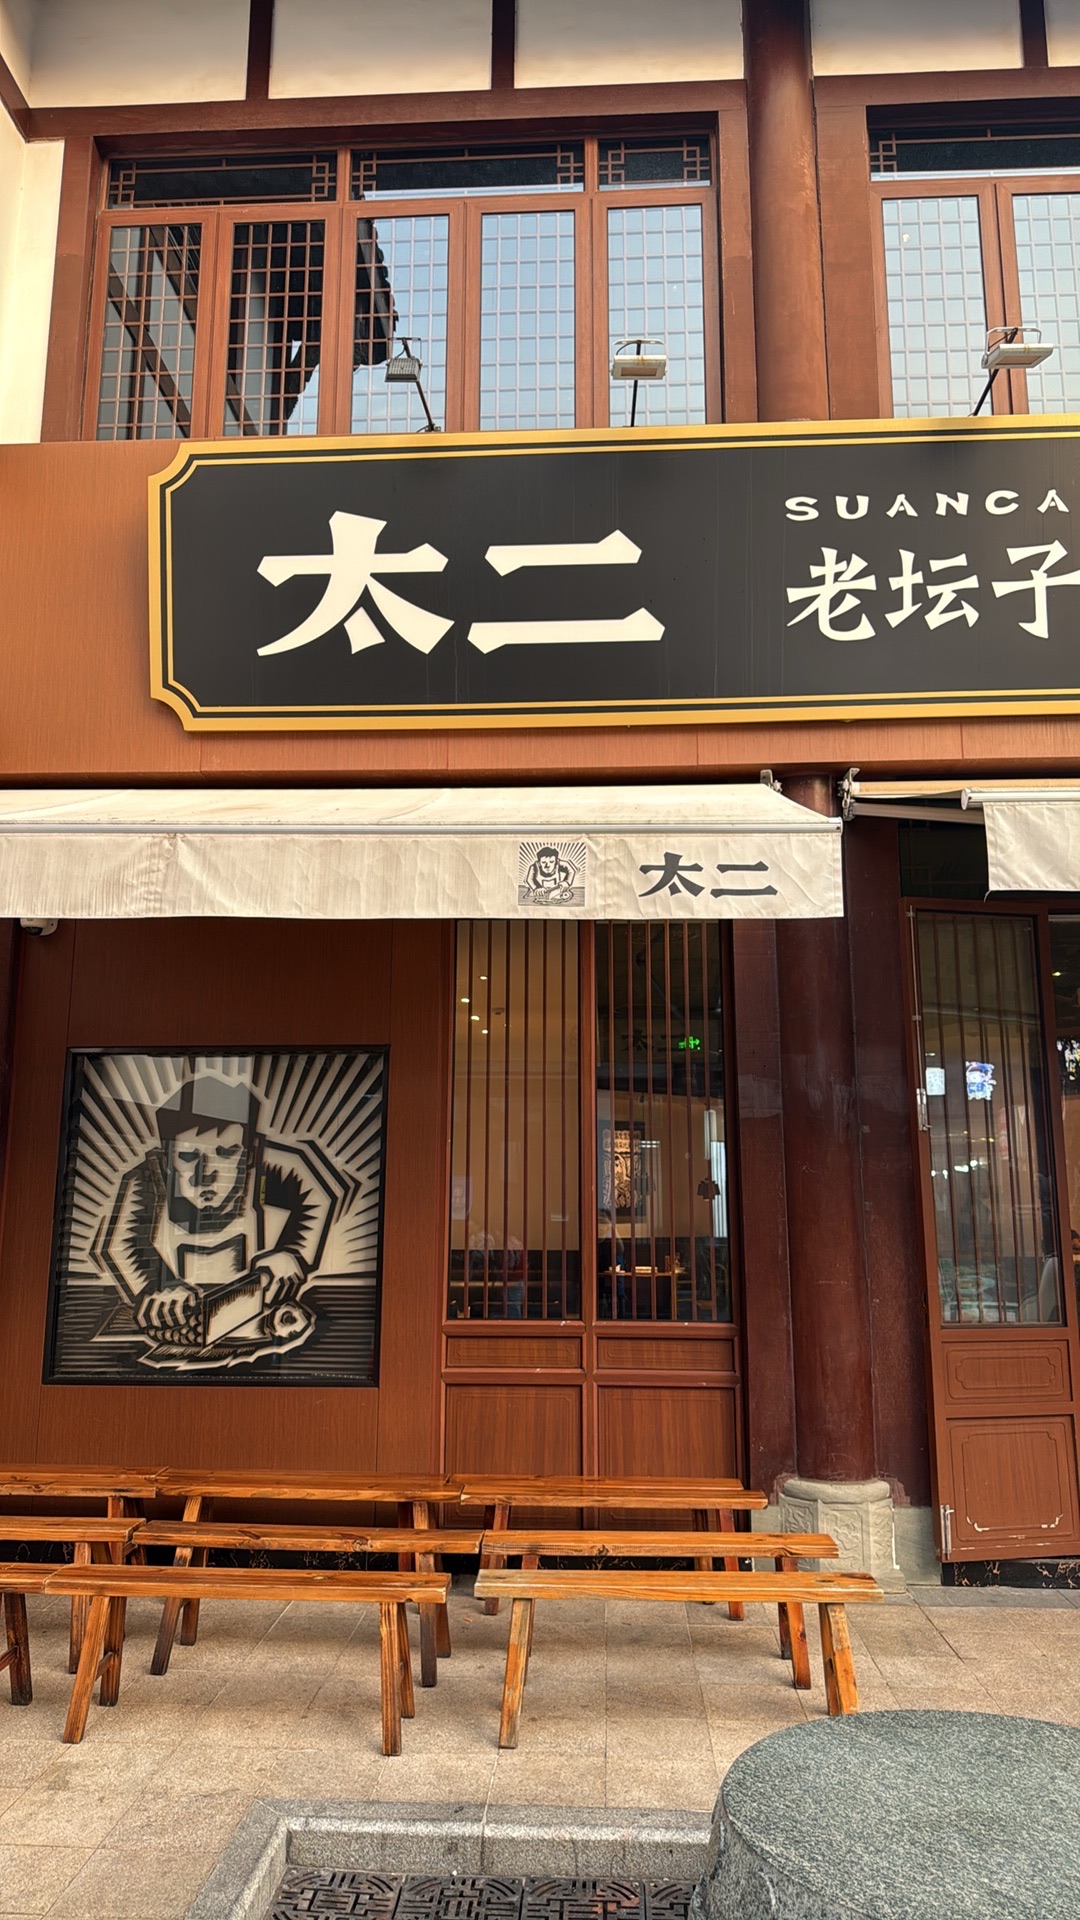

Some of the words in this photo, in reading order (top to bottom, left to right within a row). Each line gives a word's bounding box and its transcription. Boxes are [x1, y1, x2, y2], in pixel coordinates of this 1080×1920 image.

[784, 488, 1070, 522] SUANCA
[256, 510, 666, 657] 太二
[786, 539, 1080, 642] 老坛子
[638, 851, 778, 899] 太二
